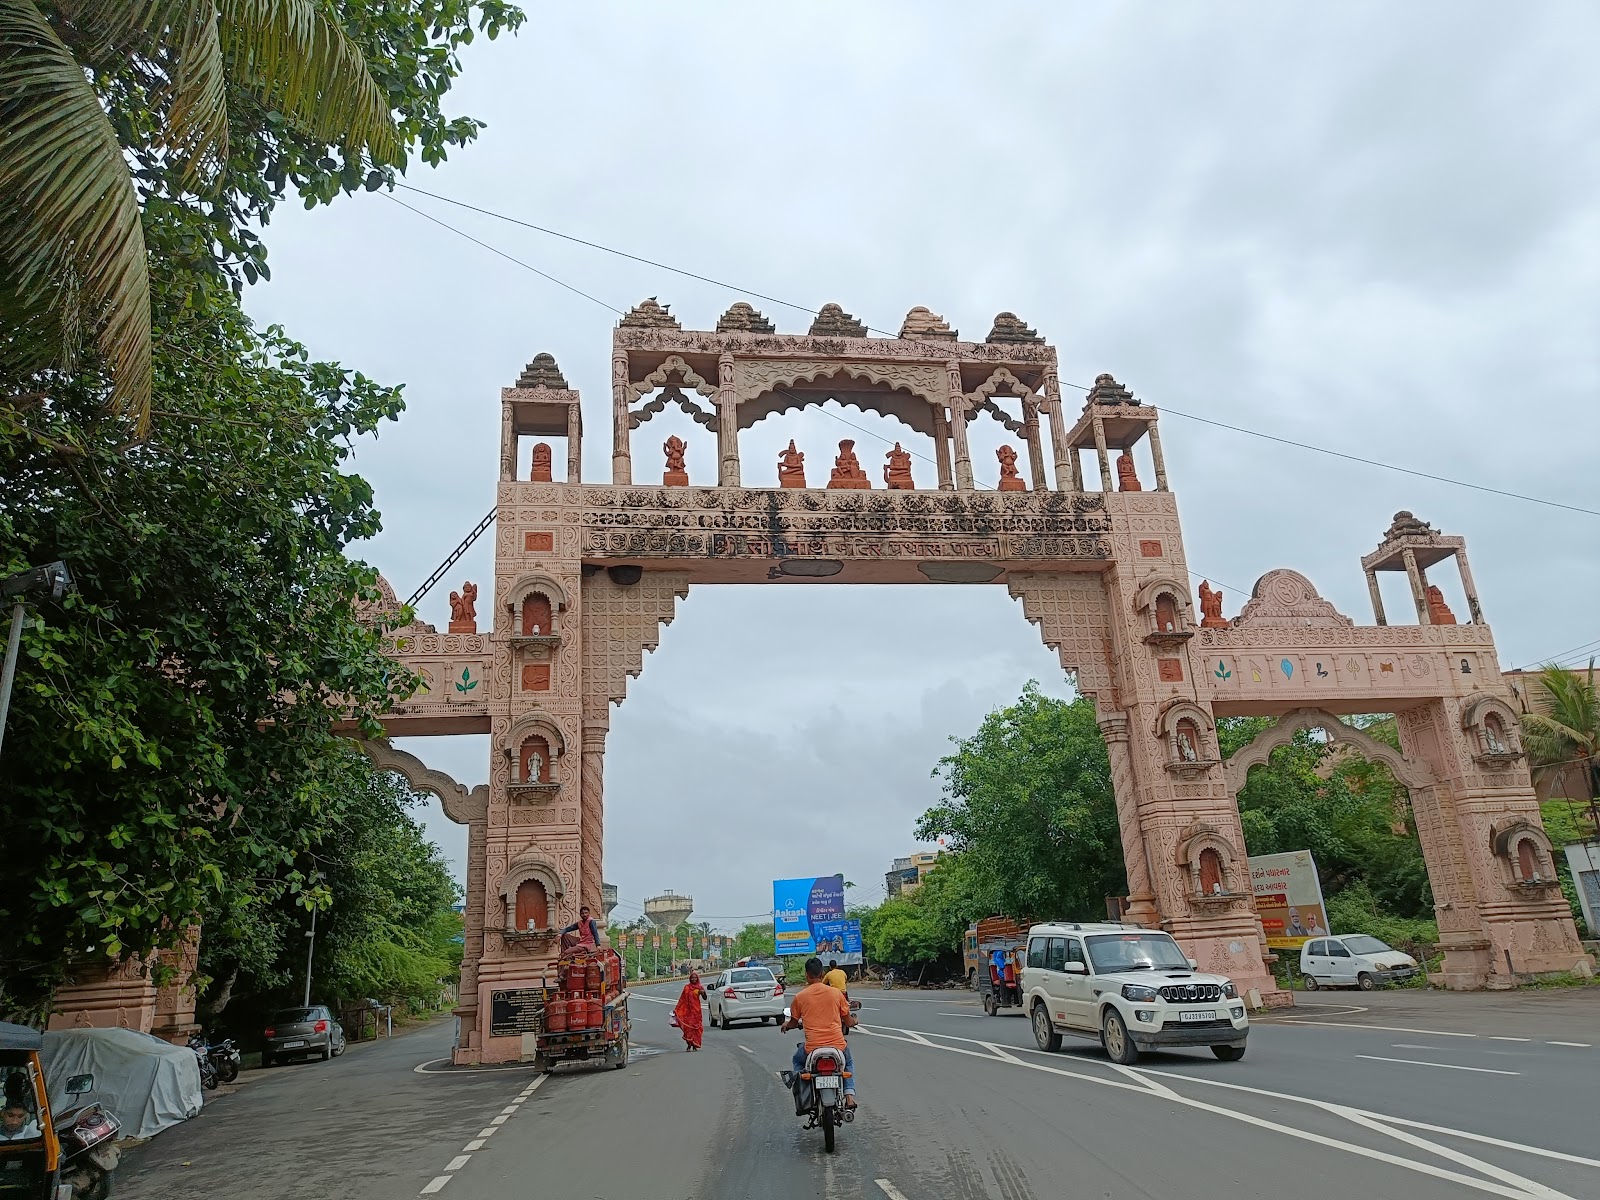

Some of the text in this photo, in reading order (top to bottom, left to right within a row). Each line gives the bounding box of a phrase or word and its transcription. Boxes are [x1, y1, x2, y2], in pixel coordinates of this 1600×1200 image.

[715, 535, 999, 556] श्री सोमनाथ मंदिर प्रभास पाटण
[775, 908, 806, 917] Aakash
